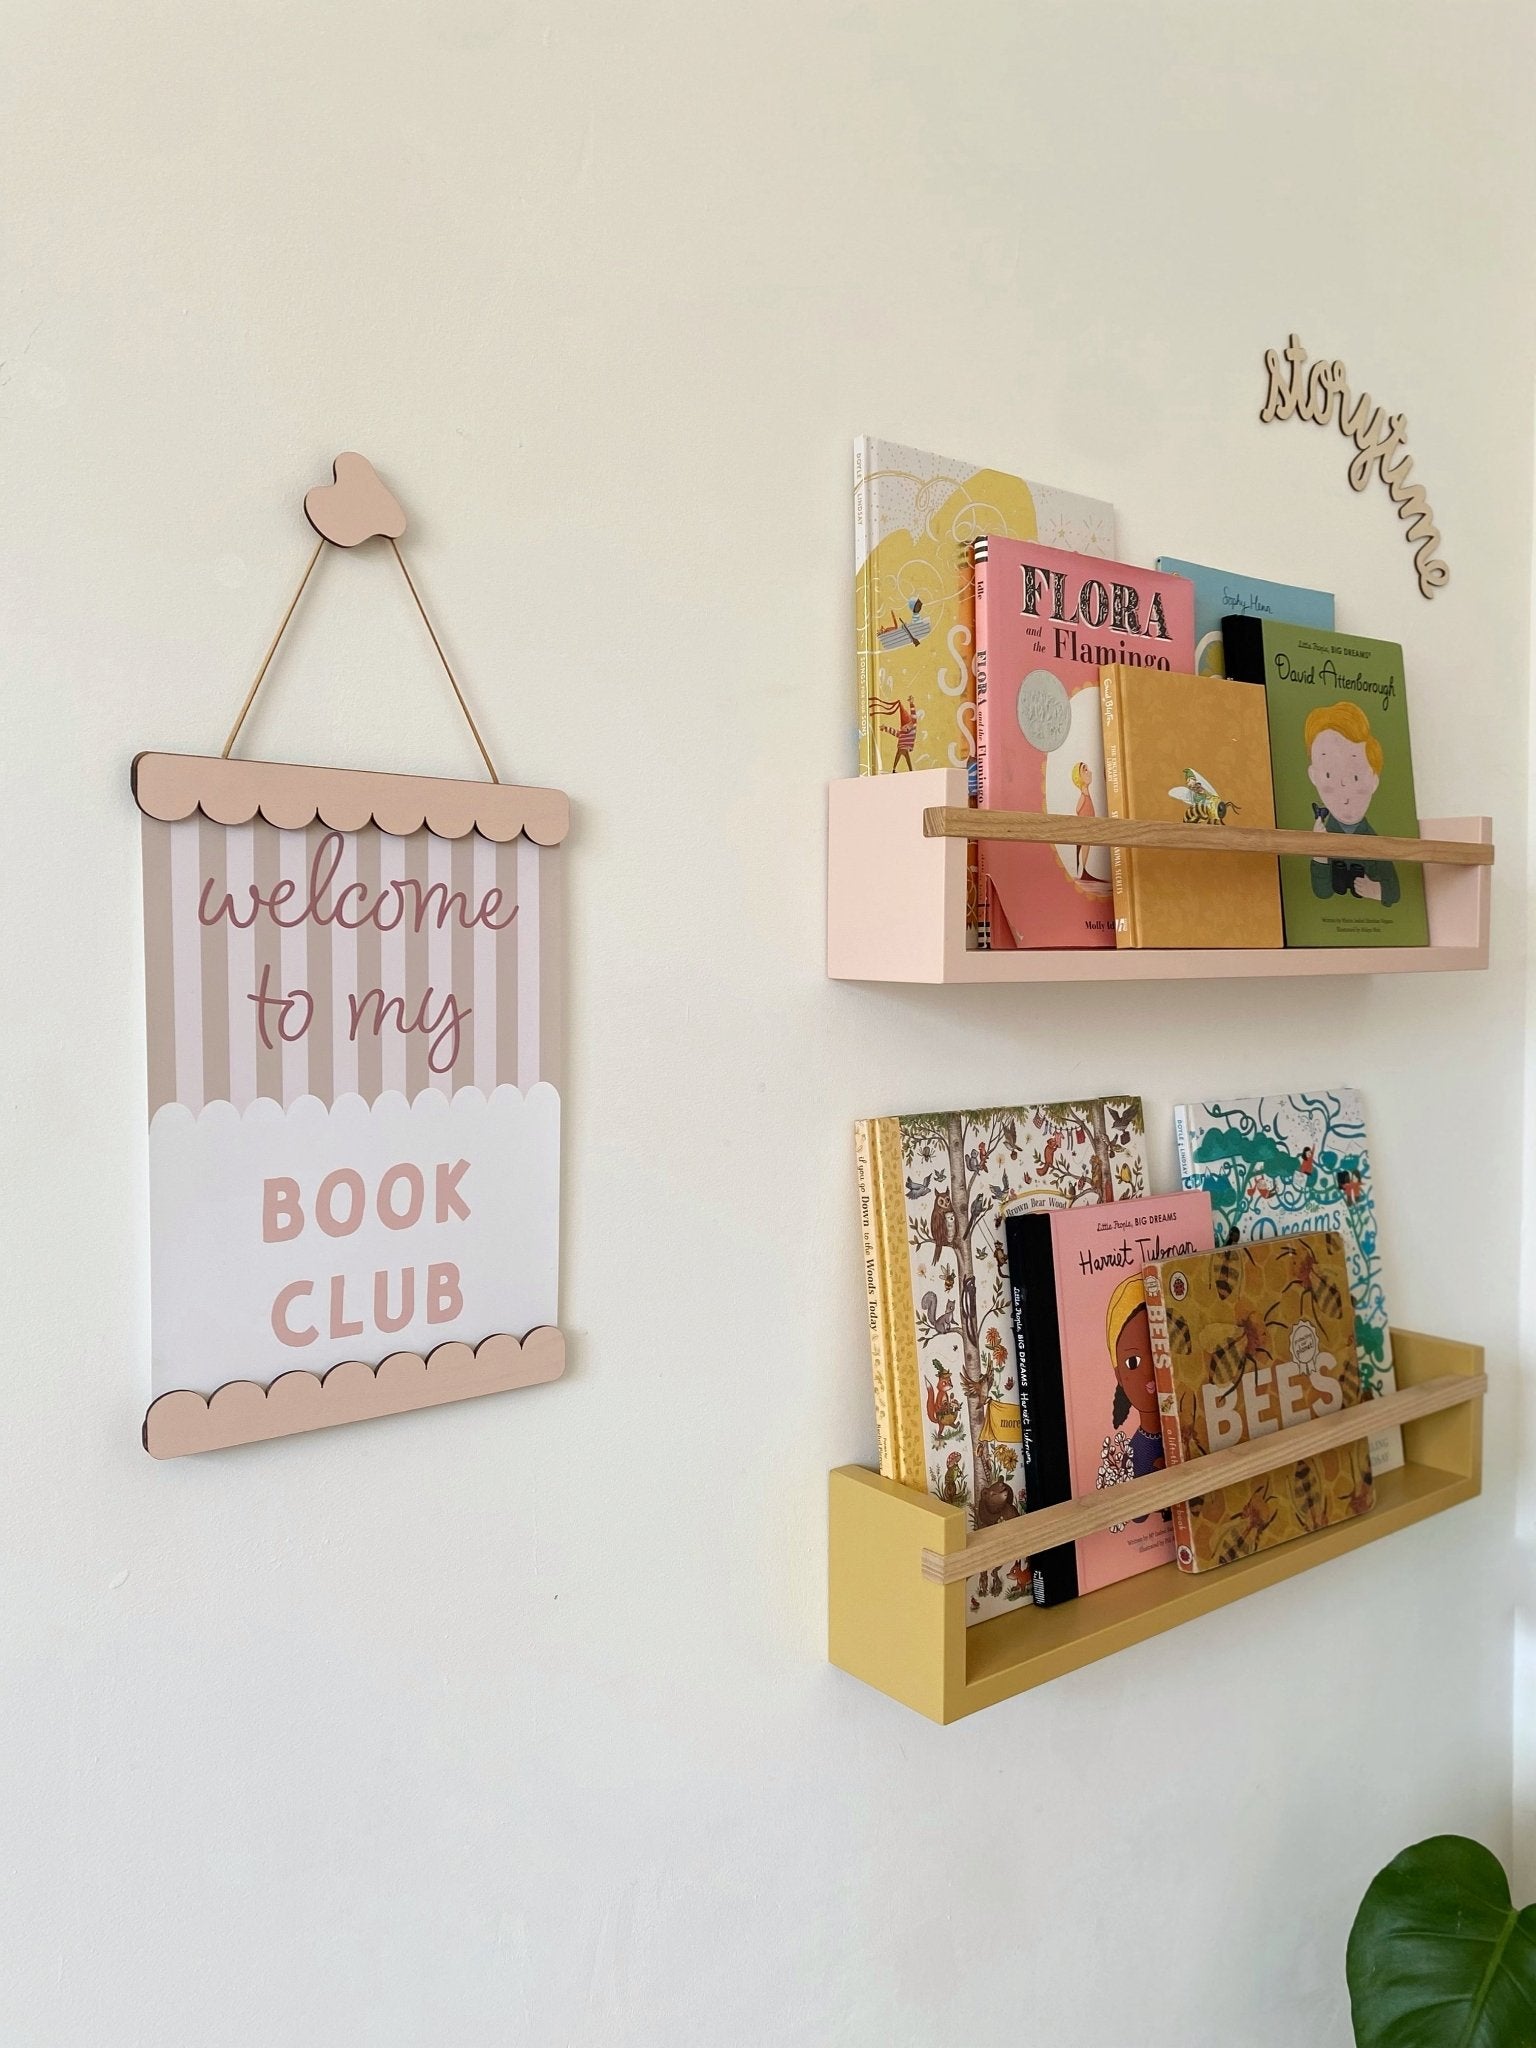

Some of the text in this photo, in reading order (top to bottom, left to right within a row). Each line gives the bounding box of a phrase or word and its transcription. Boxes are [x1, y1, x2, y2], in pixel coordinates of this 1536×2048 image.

[1259, 332, 1451, 601] storytime
[1019, 563, 1174, 643] FLORA
[1025, 625, 1043, 638] and
[1032, 640, 1047, 654] the
[1053, 627, 1171, 670] Flamingo
[1331, 645, 1342, 655] BIG
[976, 650, 988, 706] FLORA
[1274, 653, 1397, 711] David Attenborough
[978, 744, 987, 804] Flamingo
[197, 830, 520, 934] welcome
[1084, 920, 1106, 932] Molly
[1107, 920, 1116, 930] Id
[246, 963, 473, 1074] to my
[261, 1157, 473, 1244] BOOK
[861, 1196, 870, 1227] Down
[1005, 1196, 1067, 1217] Brown Bear Wood
[1096, 1222, 1113, 1232] Little
[1134, 1216, 1147, 1227] BIG
[1149, 1212, 1177, 1224] DREAMS
[866, 1258, 876, 1295] Woods
[1078, 1234, 1197, 1276] Harriet Tubman
[270, 1261, 465, 1348] CLUB
[868, 1299, 878, 1332] Today
[1013, 1286, 1021, 1307] Little
[1017, 1334, 1025, 1350] BIG
[1148, 1305, 1172, 1368] BEES
[1000, 1419, 1020, 1428] more
[1202, 1352, 1344, 1453] BEES
